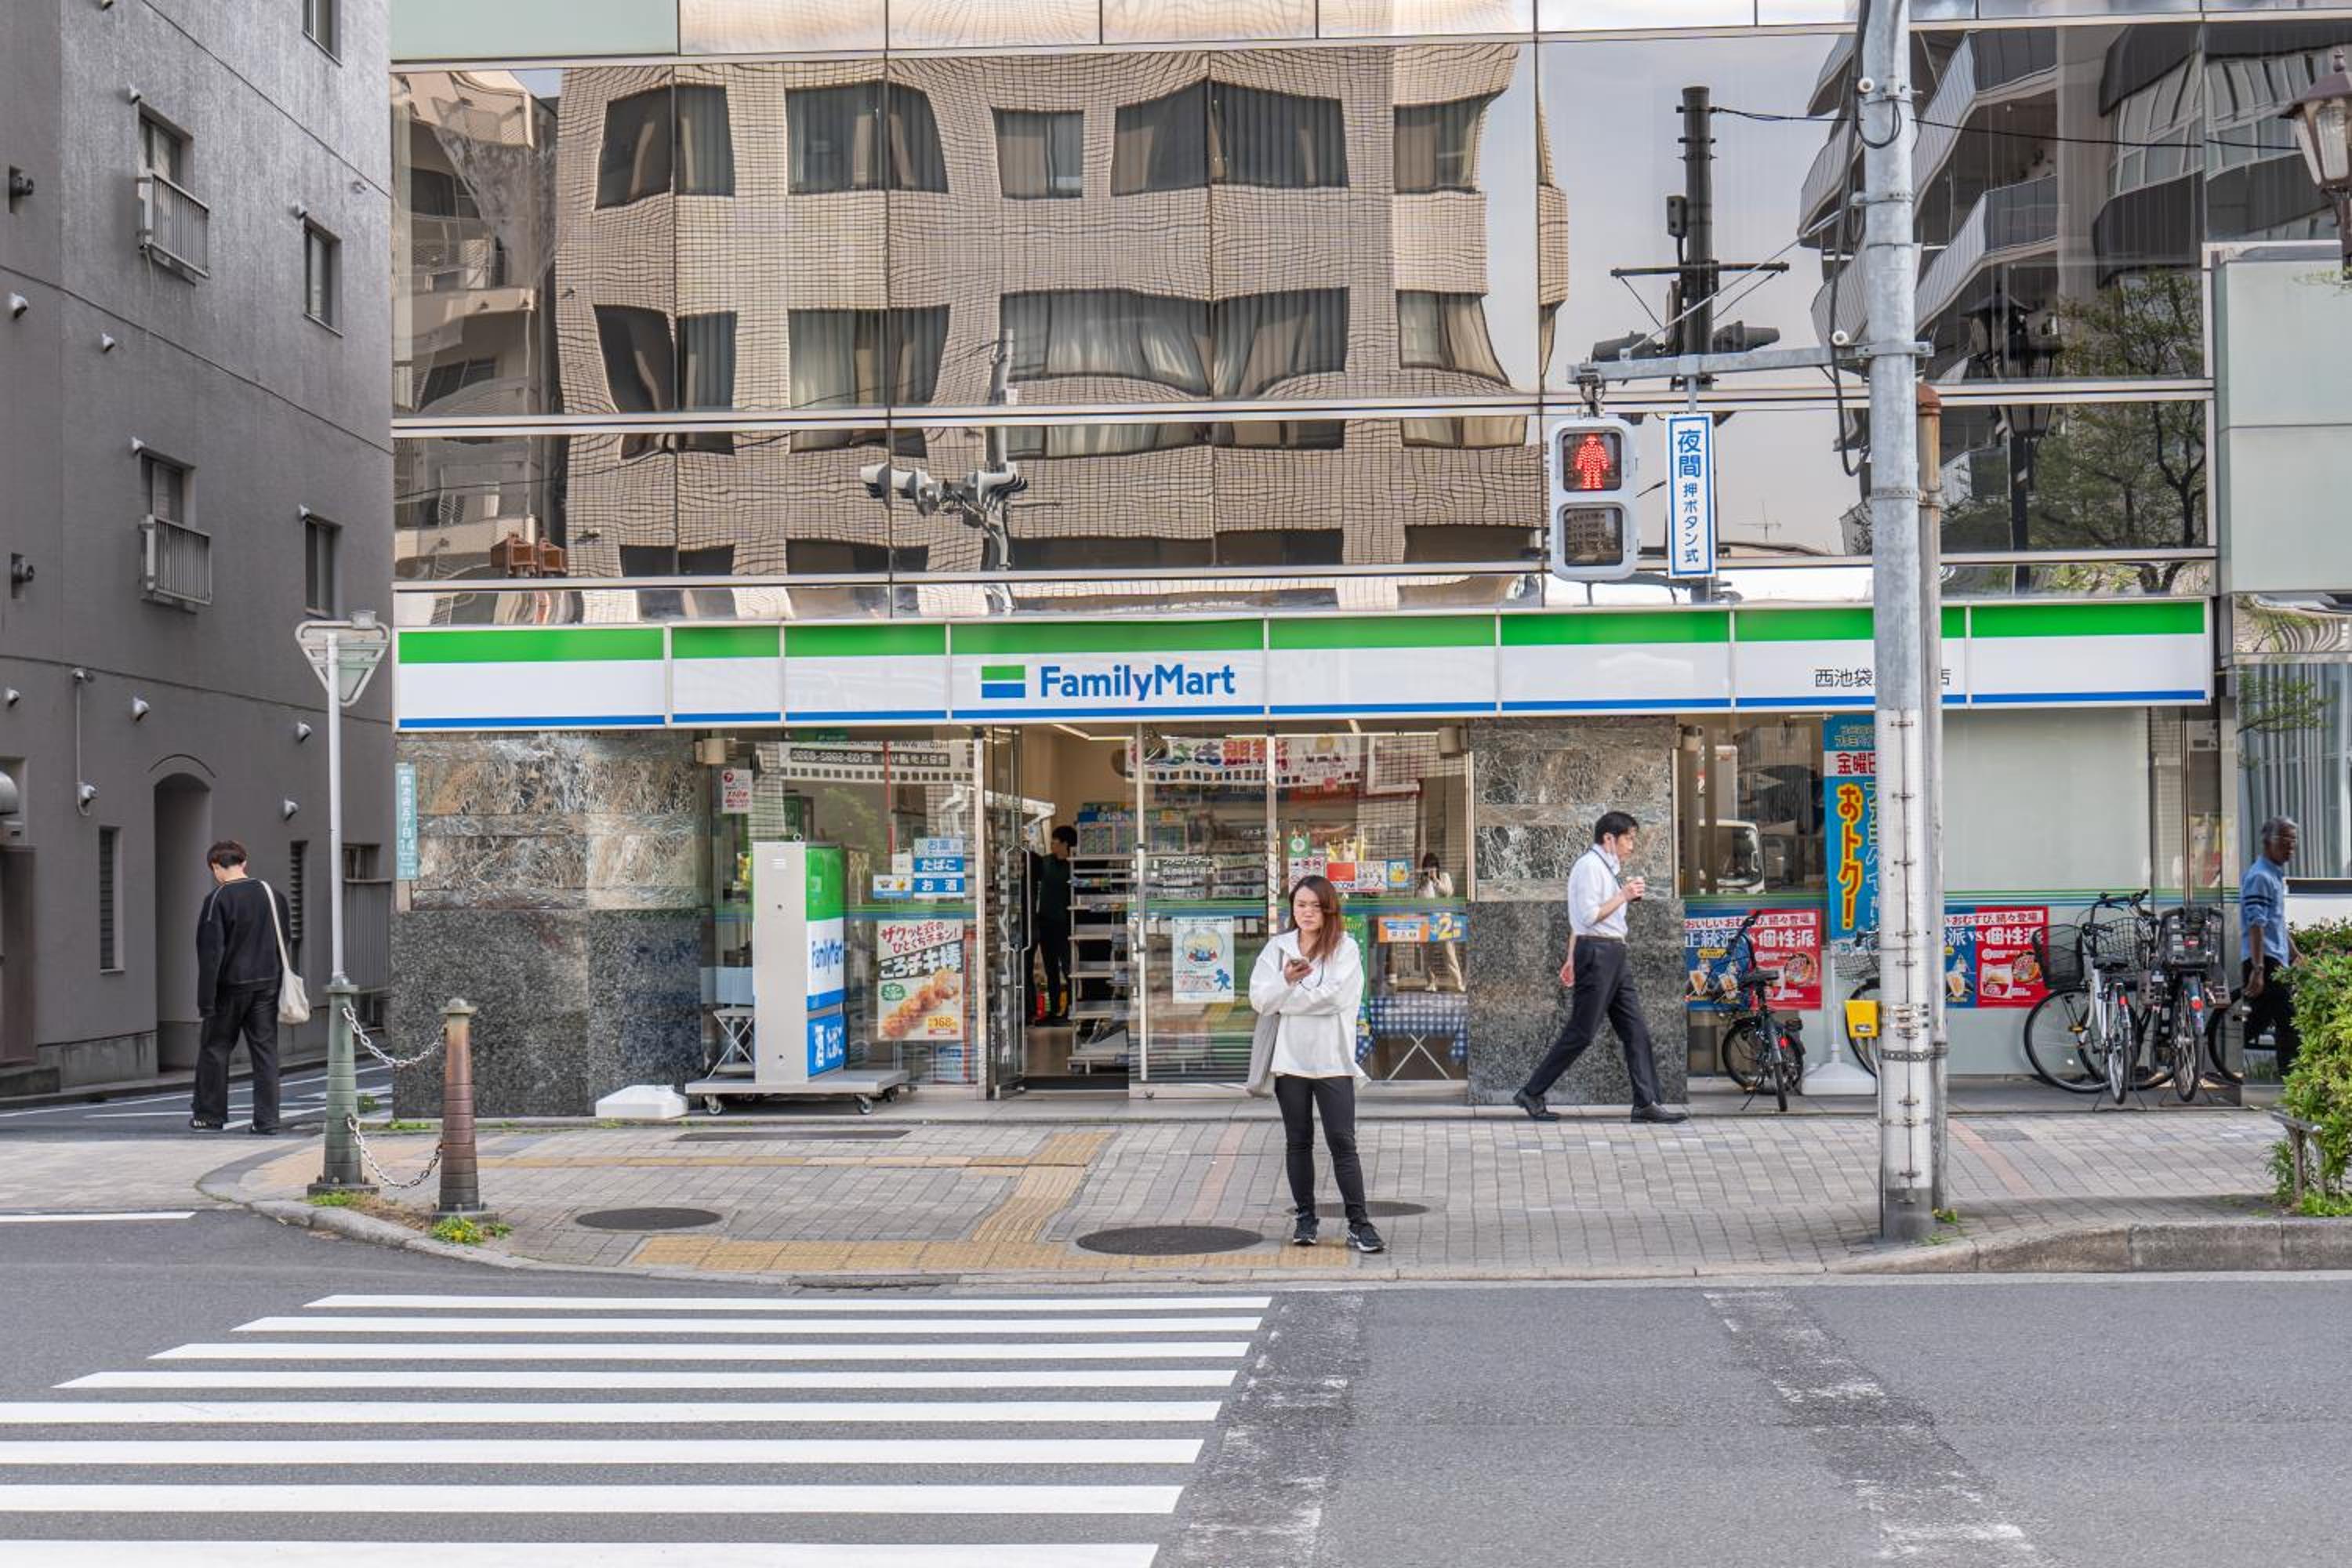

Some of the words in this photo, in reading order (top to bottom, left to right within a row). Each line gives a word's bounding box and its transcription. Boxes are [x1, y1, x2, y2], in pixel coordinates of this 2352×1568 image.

[1678, 429, 1701, 478] 夜間
[1682, 482, 1699, 563] 押ボタン式
[1040, 664, 1236, 701] FamilyMart
[921, 858, 956, 871] たばこ
[1758, 929, 1815, 947] 個性派
[880, 942, 962, 979] ころチキ棒
[815, 1025, 825, 1067] 酒
